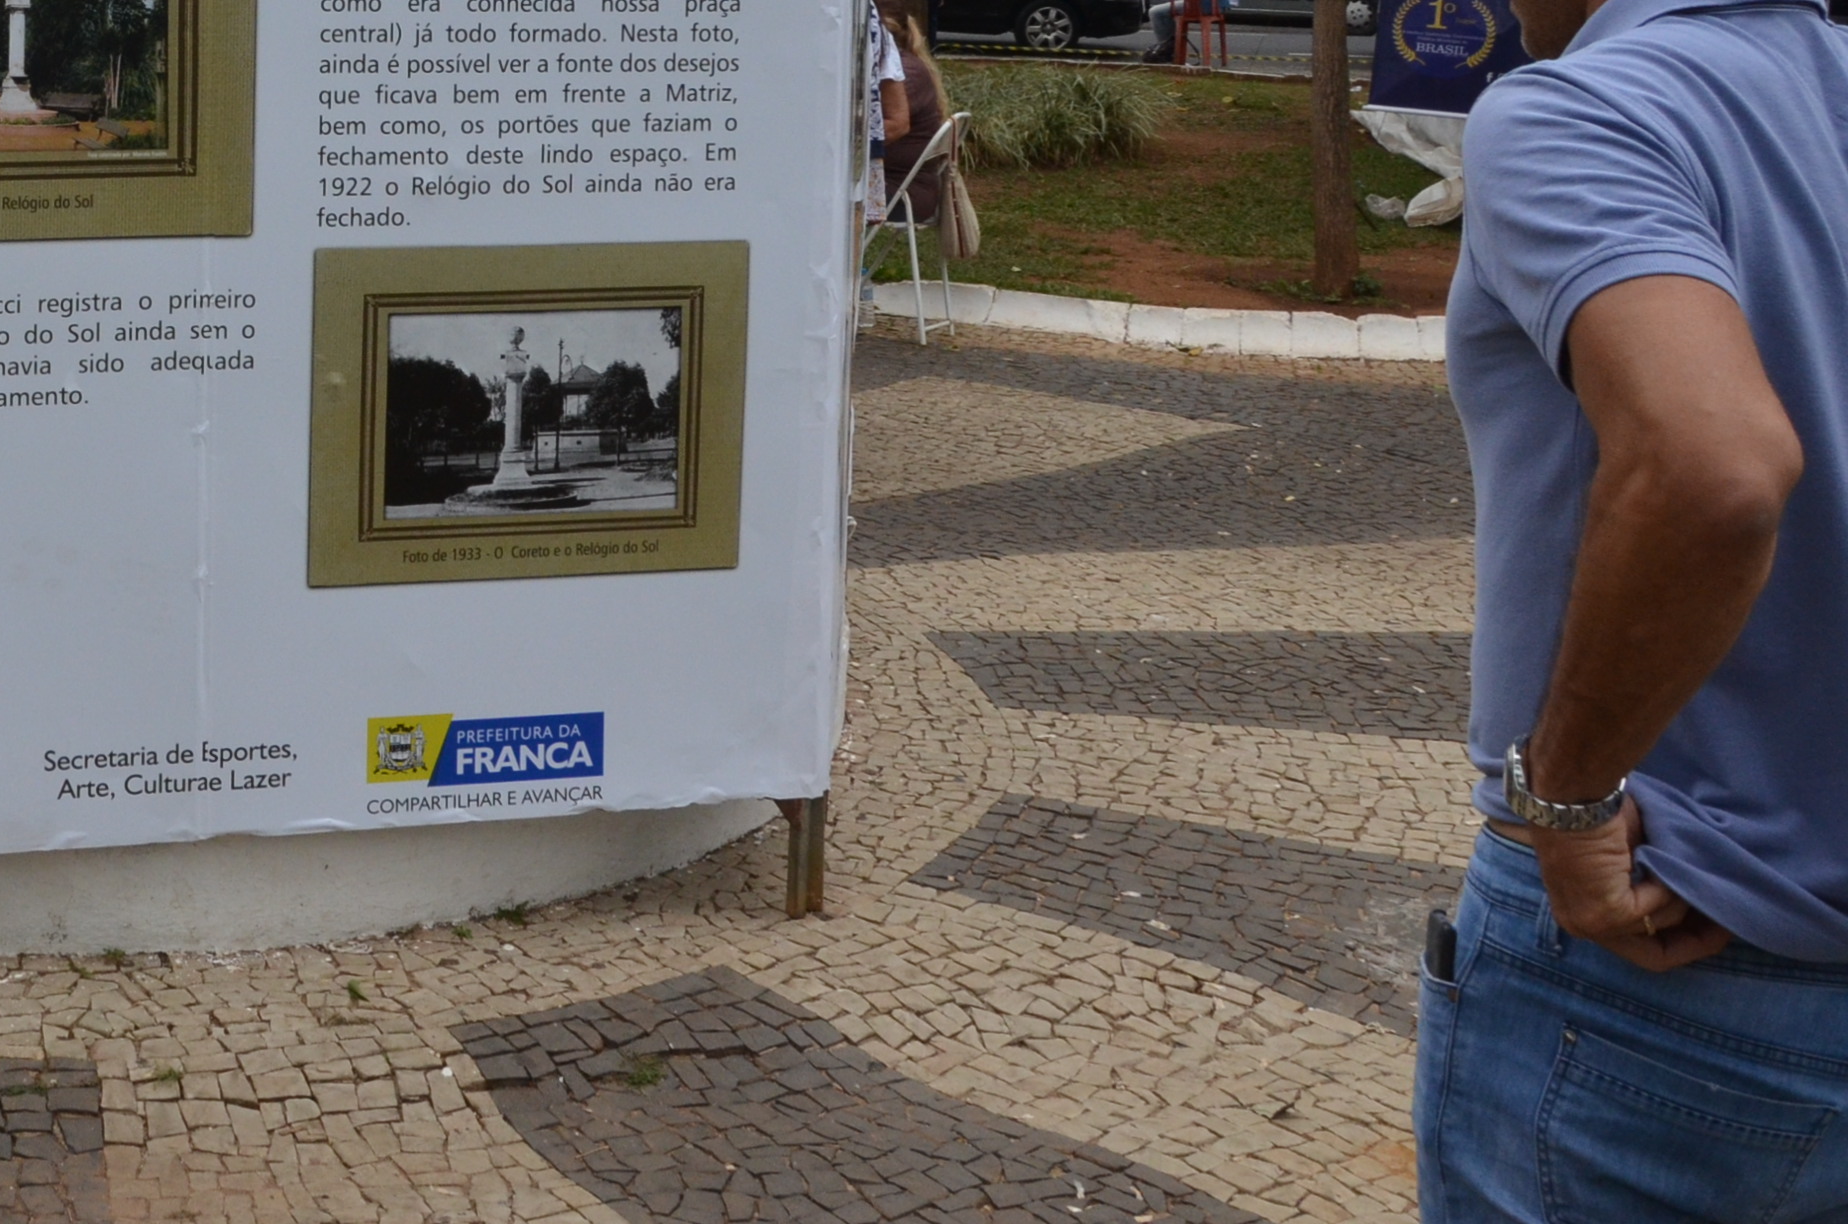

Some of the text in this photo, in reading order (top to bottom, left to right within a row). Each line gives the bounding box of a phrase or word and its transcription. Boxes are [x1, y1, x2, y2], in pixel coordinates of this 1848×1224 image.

[320, 21, 740, 48] central) já todo formado. Nesta foto,
[1415, 42, 1470, 57] BRASIL
[2, 194, 51, 213] Relógio
[53, 193, 72, 209] do
[74, 192, 95, 209] Sol
[316, 205, 411, 228] fechado.
[38, 291, 123, 318] registra
[139, 294, 153, 310] o
[24, 322, 54, 344] do
[68, 321, 101, 343] Sol
[114, 319, 177, 342] ainda
[242, 323, 256, 339] o
[78, 351, 125, 374] sido
[403, 538, 660, 563] Foto de 1933 O Coreto e o Relógio do Sol
[457, 723, 582, 744] PREFEITURA DA
[44, 745, 160, 772] Secretaria
[166, 742, 195, 764] de
[456, 740, 594, 775] FRANCA
[57, 777, 116, 800] Arte,
[231, 768, 293, 790] Lazer
[367, 784, 604, 815] COMPARTILHAR E AVANÇAR
